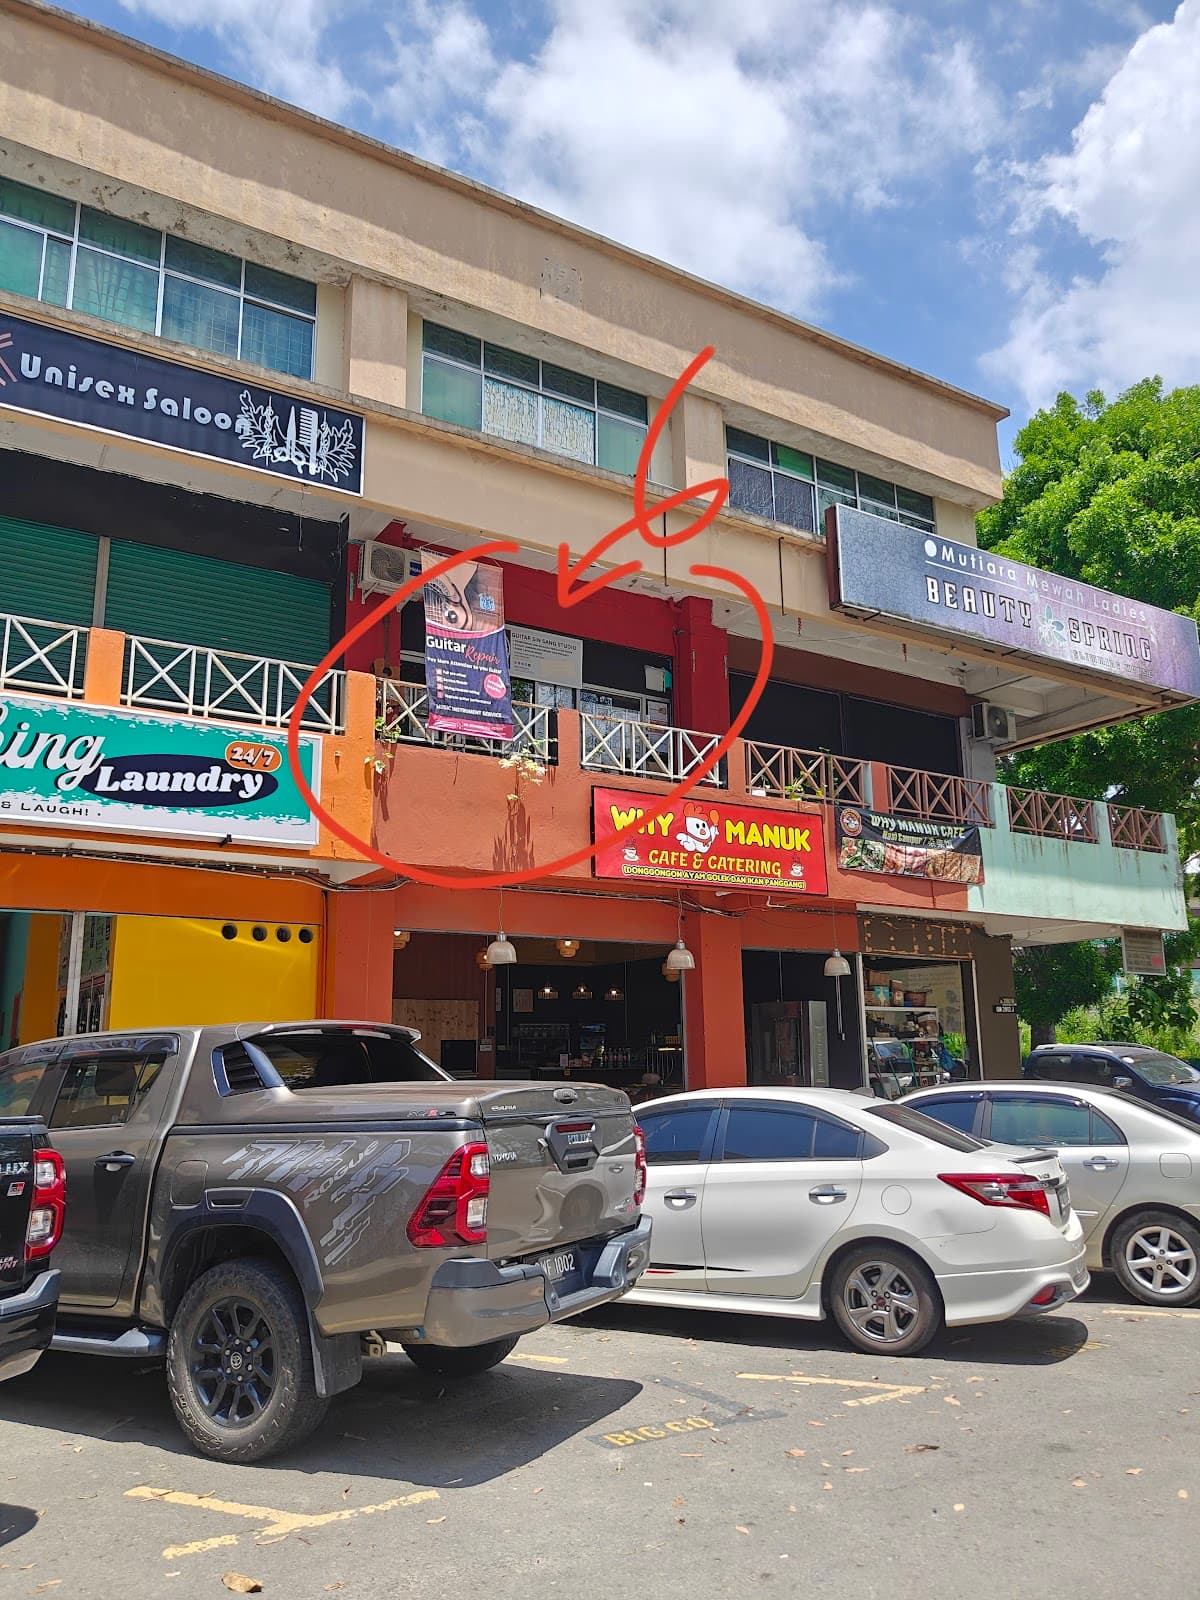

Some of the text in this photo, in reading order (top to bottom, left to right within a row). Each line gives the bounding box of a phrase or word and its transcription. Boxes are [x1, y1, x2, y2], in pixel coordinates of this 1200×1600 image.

[20, 352, 136, 405] Unisex
[942, 545, 1148, 623] Mutiara Mewah Ladies
[925, 575, 1152, 662] BEAUTY SPRING
[426, 636, 466, 653] Guitar
[465, 645, 501, 665] Repair
[511, 632, 531, 641] GUITAR
[230, 746, 276, 767] 24/7
[94, 765, 264, 798] Laundry
[21, 803, 89, 816] LAUGH!
[725, 819, 812, 853] MANUK
[870, 814, 896, 831] WHY
[897, 819, 940, 836] MANUK
[940, 826, 966, 839] CAFE
[649, 849, 782, 877] CAFE & CATERING
[683, 871, 706, 881] AYAM
[747, 877, 764, 886] IKAN
[303, 1140, 379, 1208] ROGUE
[554, 1253, 576, 1274] 1002
[603, 1425, 666, 1447] BIG
